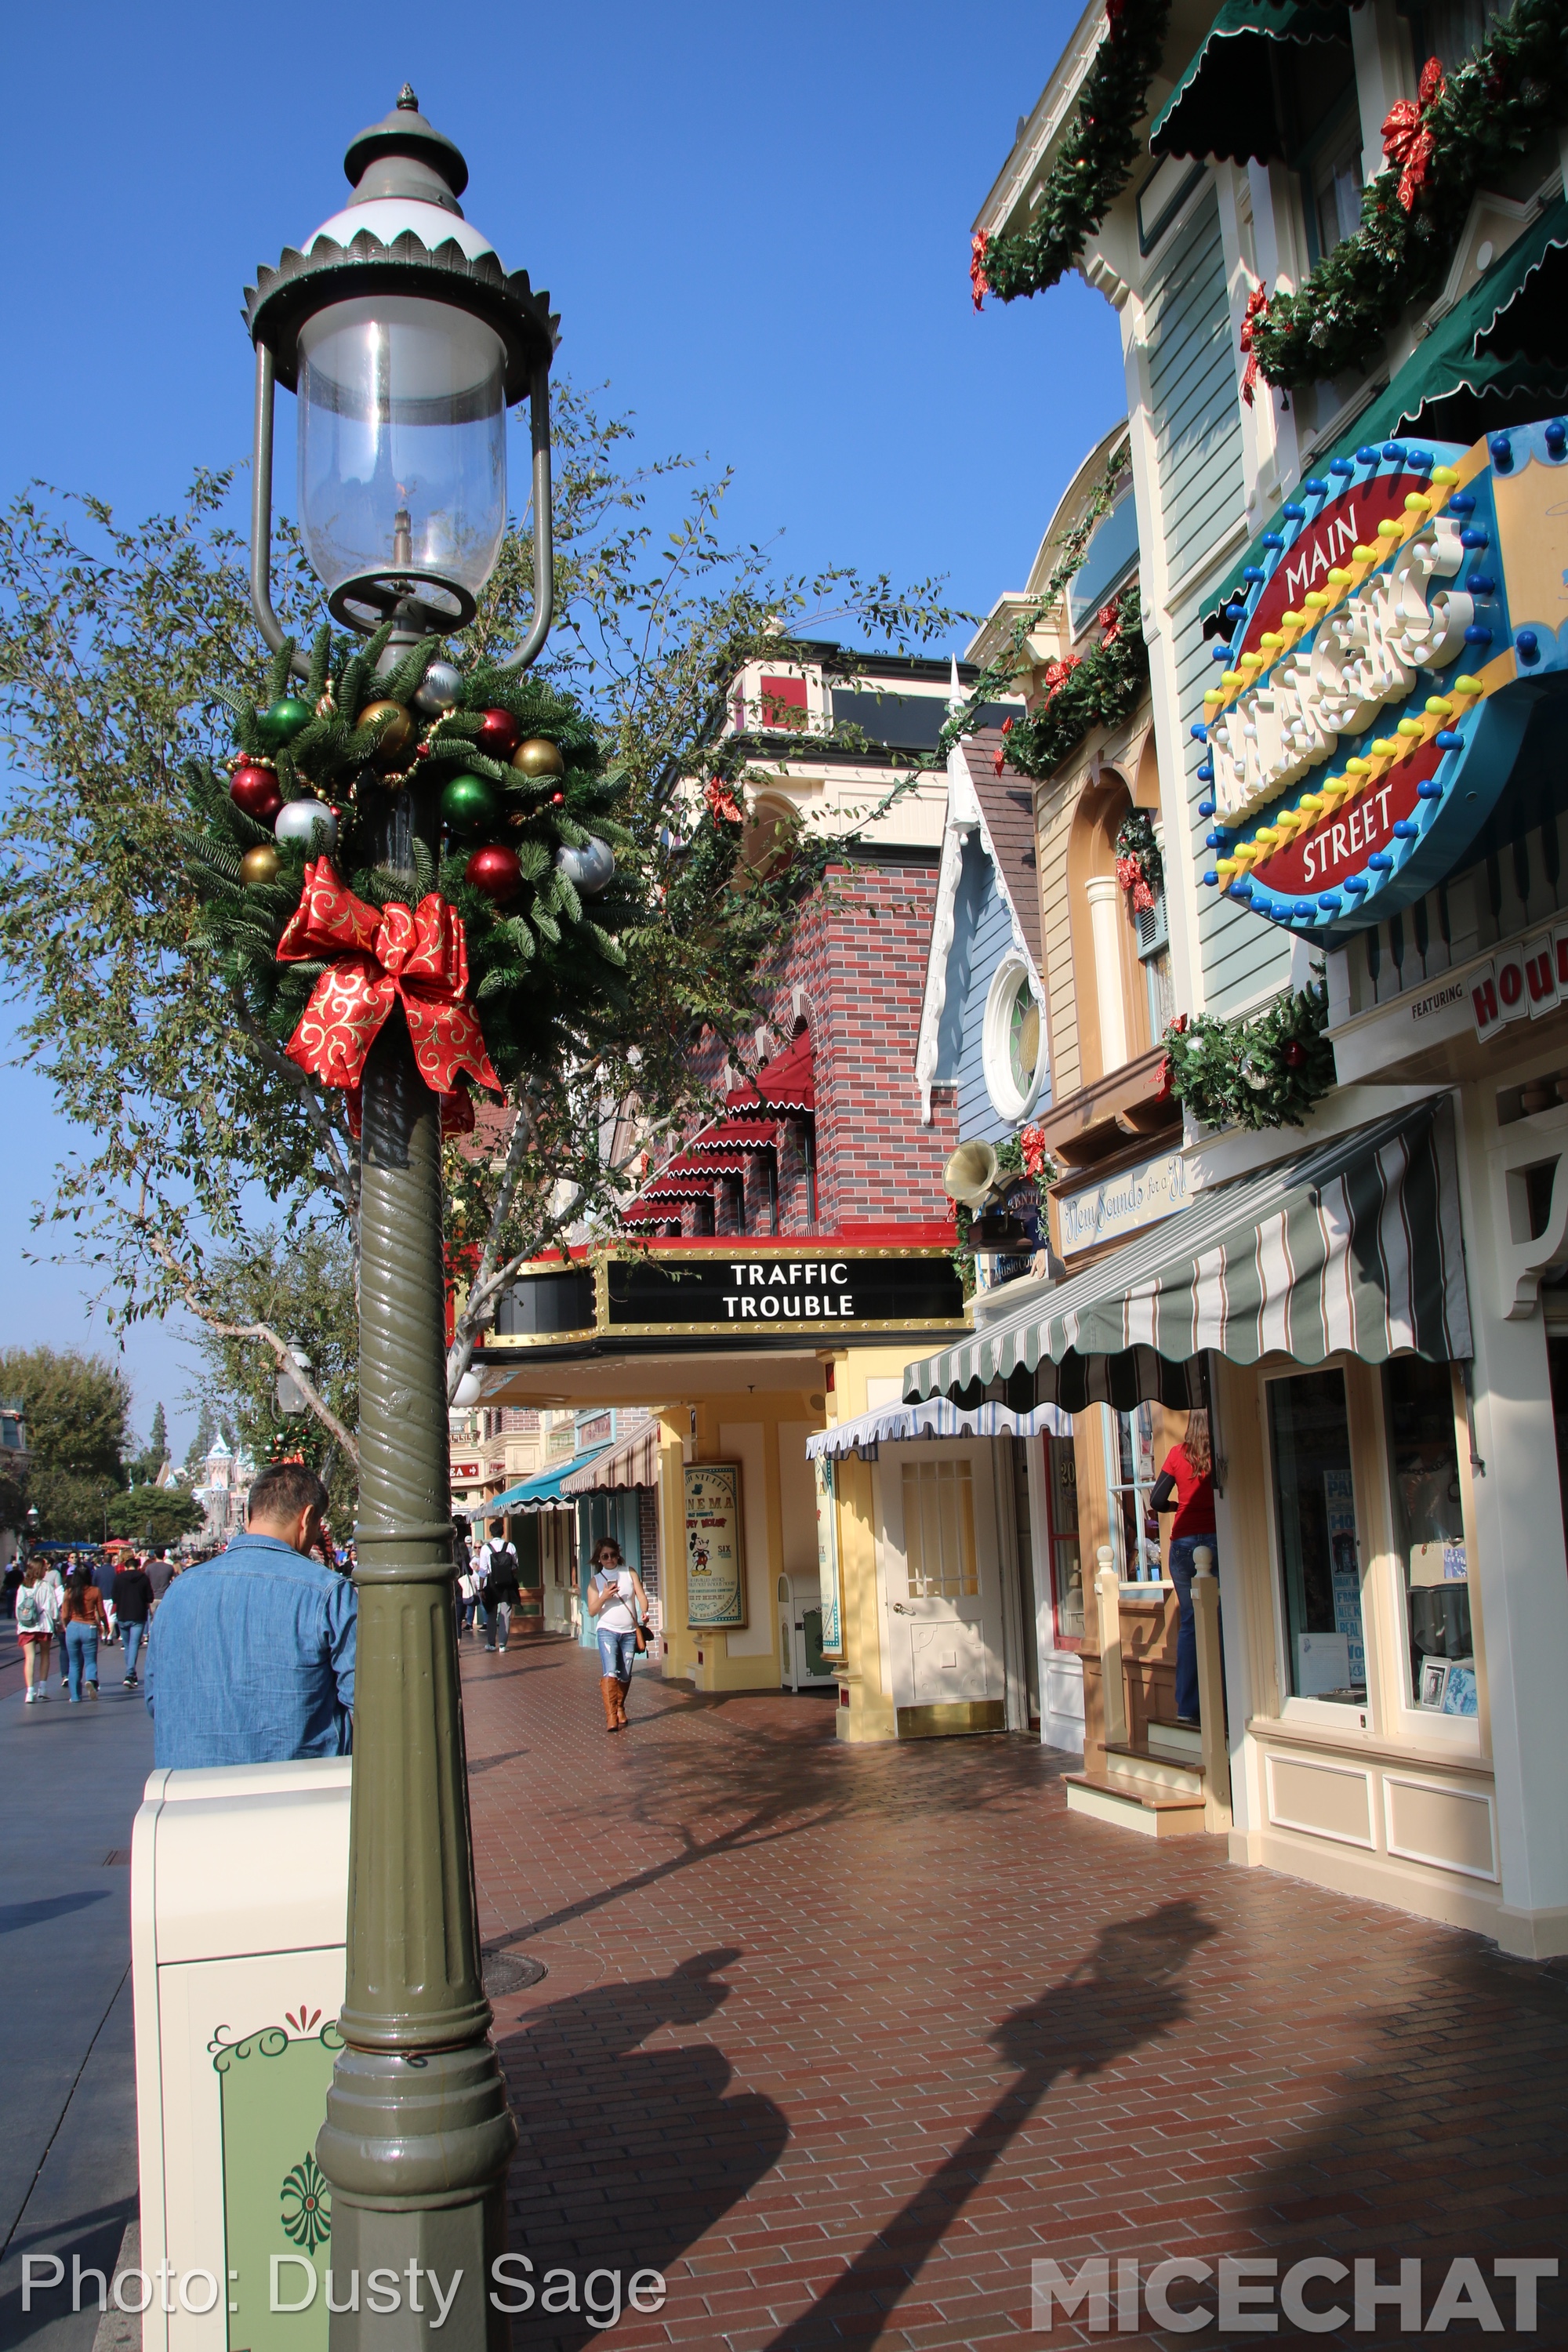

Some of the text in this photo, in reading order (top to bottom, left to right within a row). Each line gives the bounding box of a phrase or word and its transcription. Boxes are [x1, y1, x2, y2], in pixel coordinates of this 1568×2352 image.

[1285, 503, 1359, 604] MAIN
[1207, 517, 1474, 828] MAGIC
[1303, 784, 1392, 883] STREET
[1412, 983, 1462, 1019] FEATURING
[1096, 1174, 1145, 1232] Sounds
[1147, 1177, 1160, 1200] for
[1161, 1177, 1167, 1189] a
[731, 1263, 848, 1285] TRAFFIC
[993, 1258, 1018, 1282] Music
[722, 1295, 855, 1317] TROUBLE
[685, 1497, 734, 1511] NEMA
[717, 1544, 731, 1553] SIX
